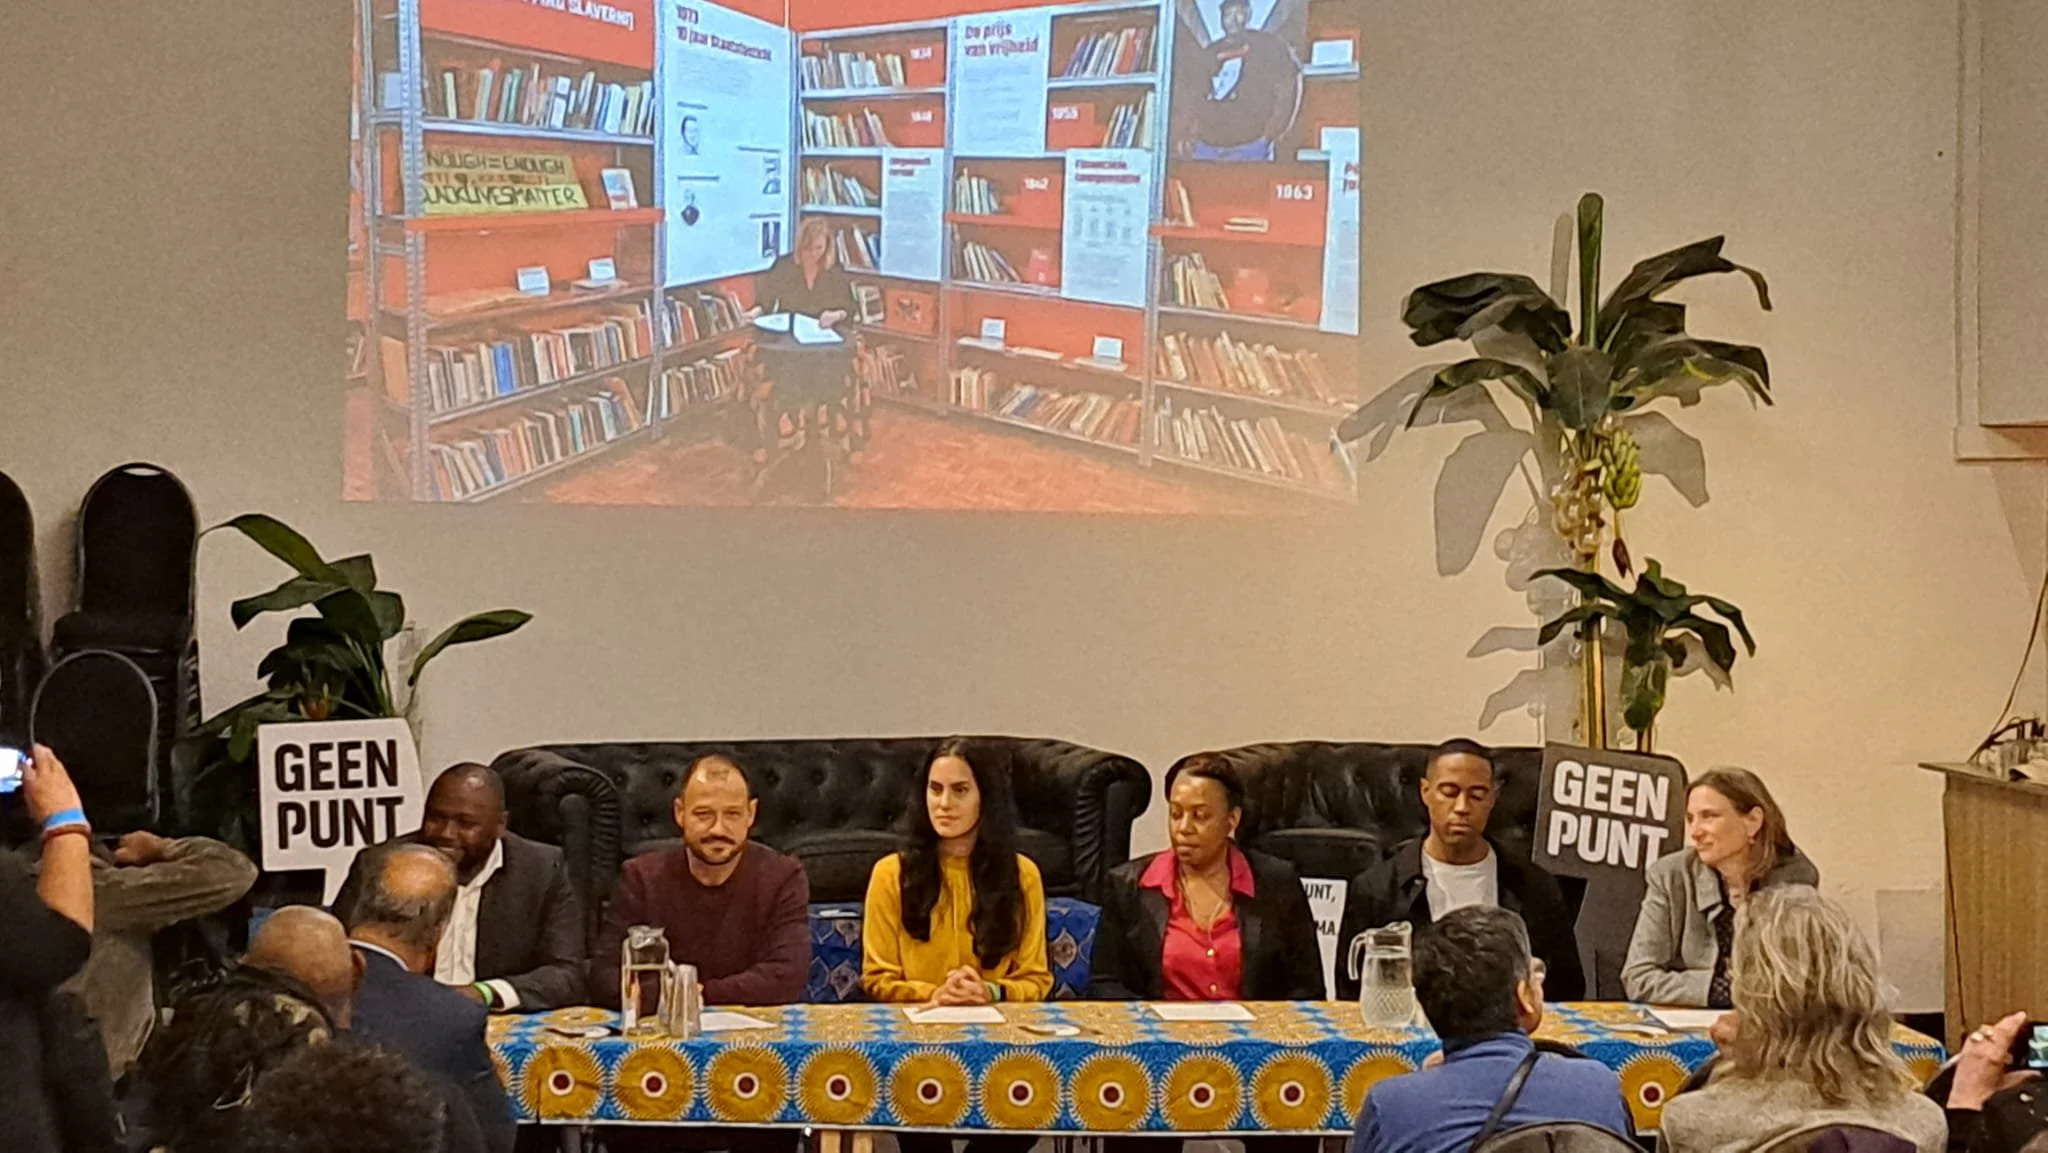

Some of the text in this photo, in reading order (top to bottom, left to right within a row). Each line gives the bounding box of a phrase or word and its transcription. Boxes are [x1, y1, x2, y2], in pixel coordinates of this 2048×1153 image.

[964, 33, 1040, 57] van vrijheid
[965, 21, 1013, 40] De prijs
[423, 182, 580, 207] LACKLIVESMATTER
[1275, 183, 1314, 201] 1863
[275, 739, 398, 792] GEEN
[1553, 760, 1670, 822] GEEN
[277, 796, 404, 850] PUNT
[1547, 810, 1670, 873] PUNT
